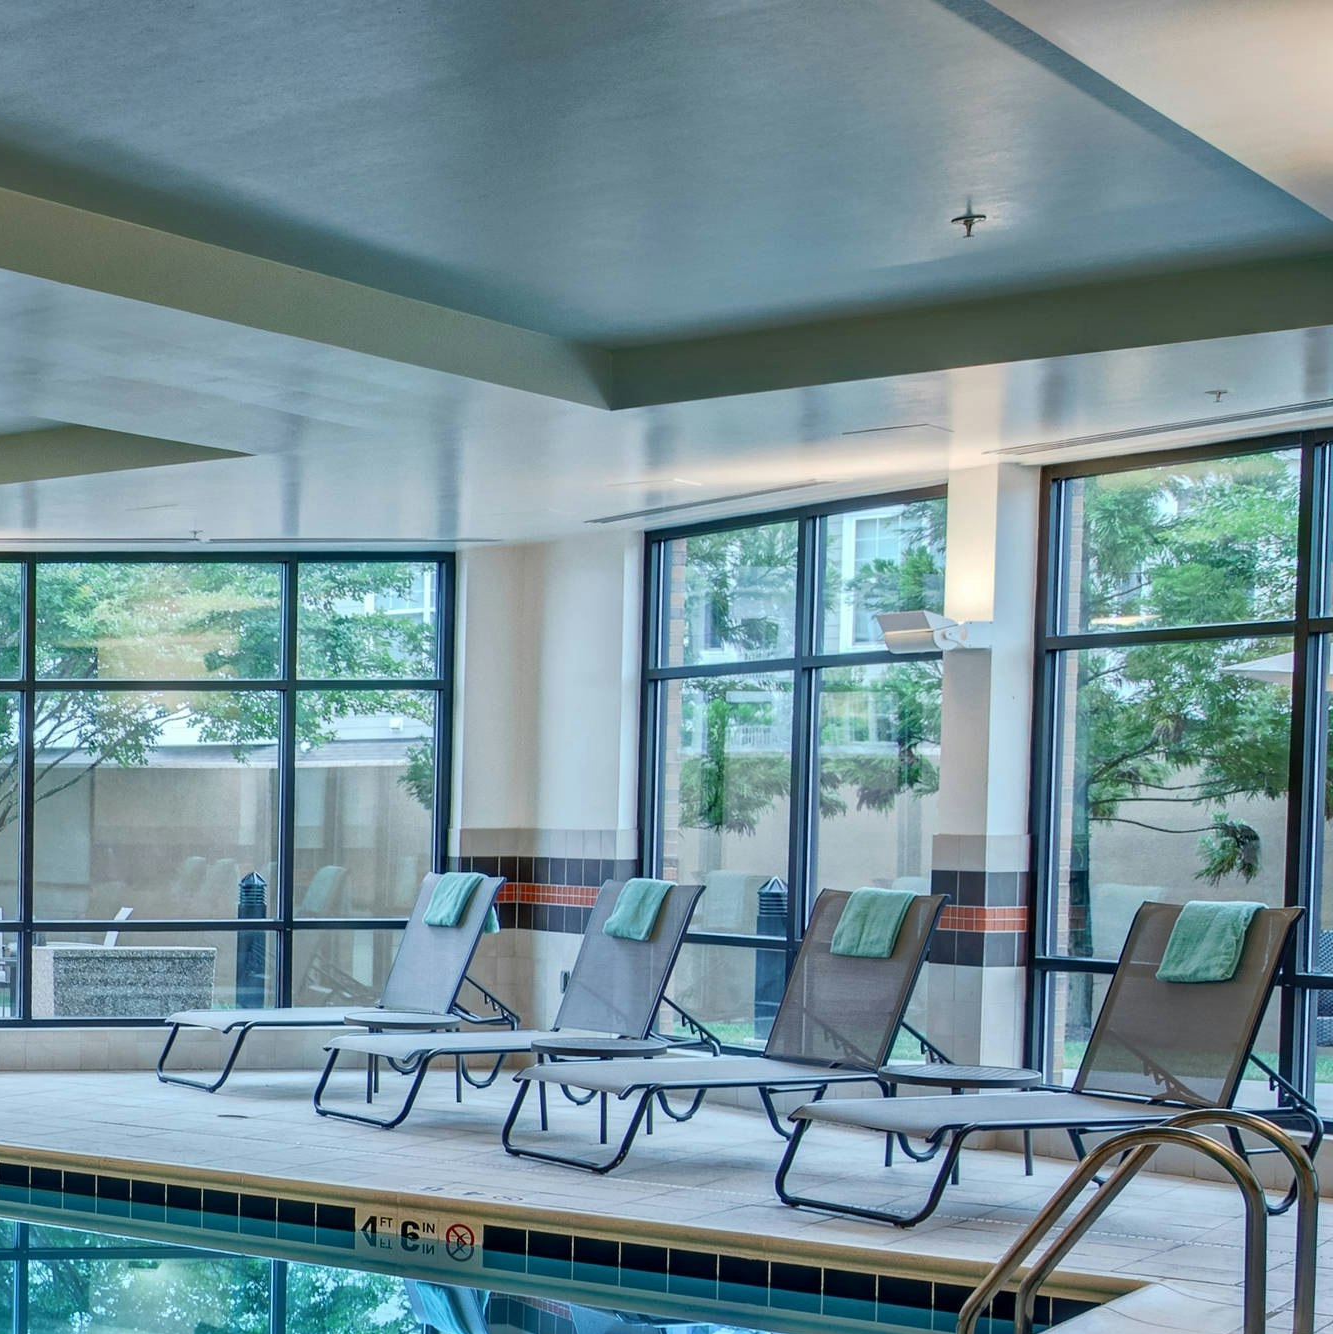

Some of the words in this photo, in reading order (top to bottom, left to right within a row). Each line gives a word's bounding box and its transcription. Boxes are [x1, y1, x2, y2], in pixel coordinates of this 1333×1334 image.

[359, 1215, 378, 1234] 4
[380, 1216, 394, 1228] FT
[400, 1220, 420, 1240] 6
[422, 1222, 435, 1234] IN
